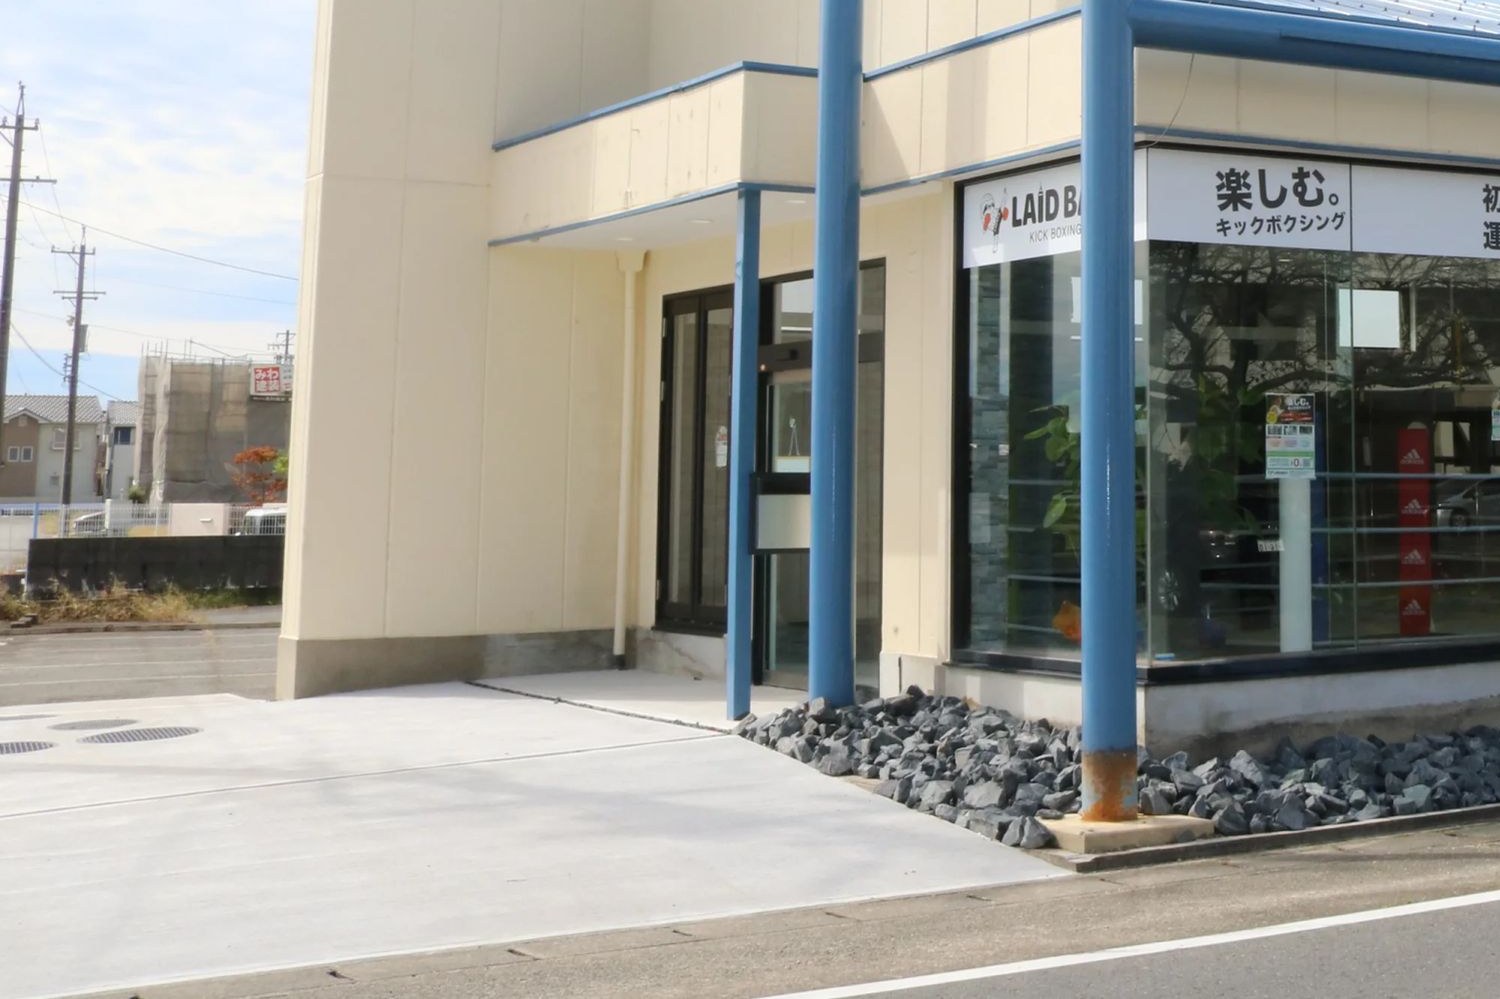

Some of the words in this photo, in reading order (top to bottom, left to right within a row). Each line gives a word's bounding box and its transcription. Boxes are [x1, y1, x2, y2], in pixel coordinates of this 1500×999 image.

[1012, 185, 1060, 228] LAID
[1216, 167, 1339, 212] 楽しむ。
[1029, 230, 1049, 243] KICK
[1216, 211, 1346, 237] キックボクシング
